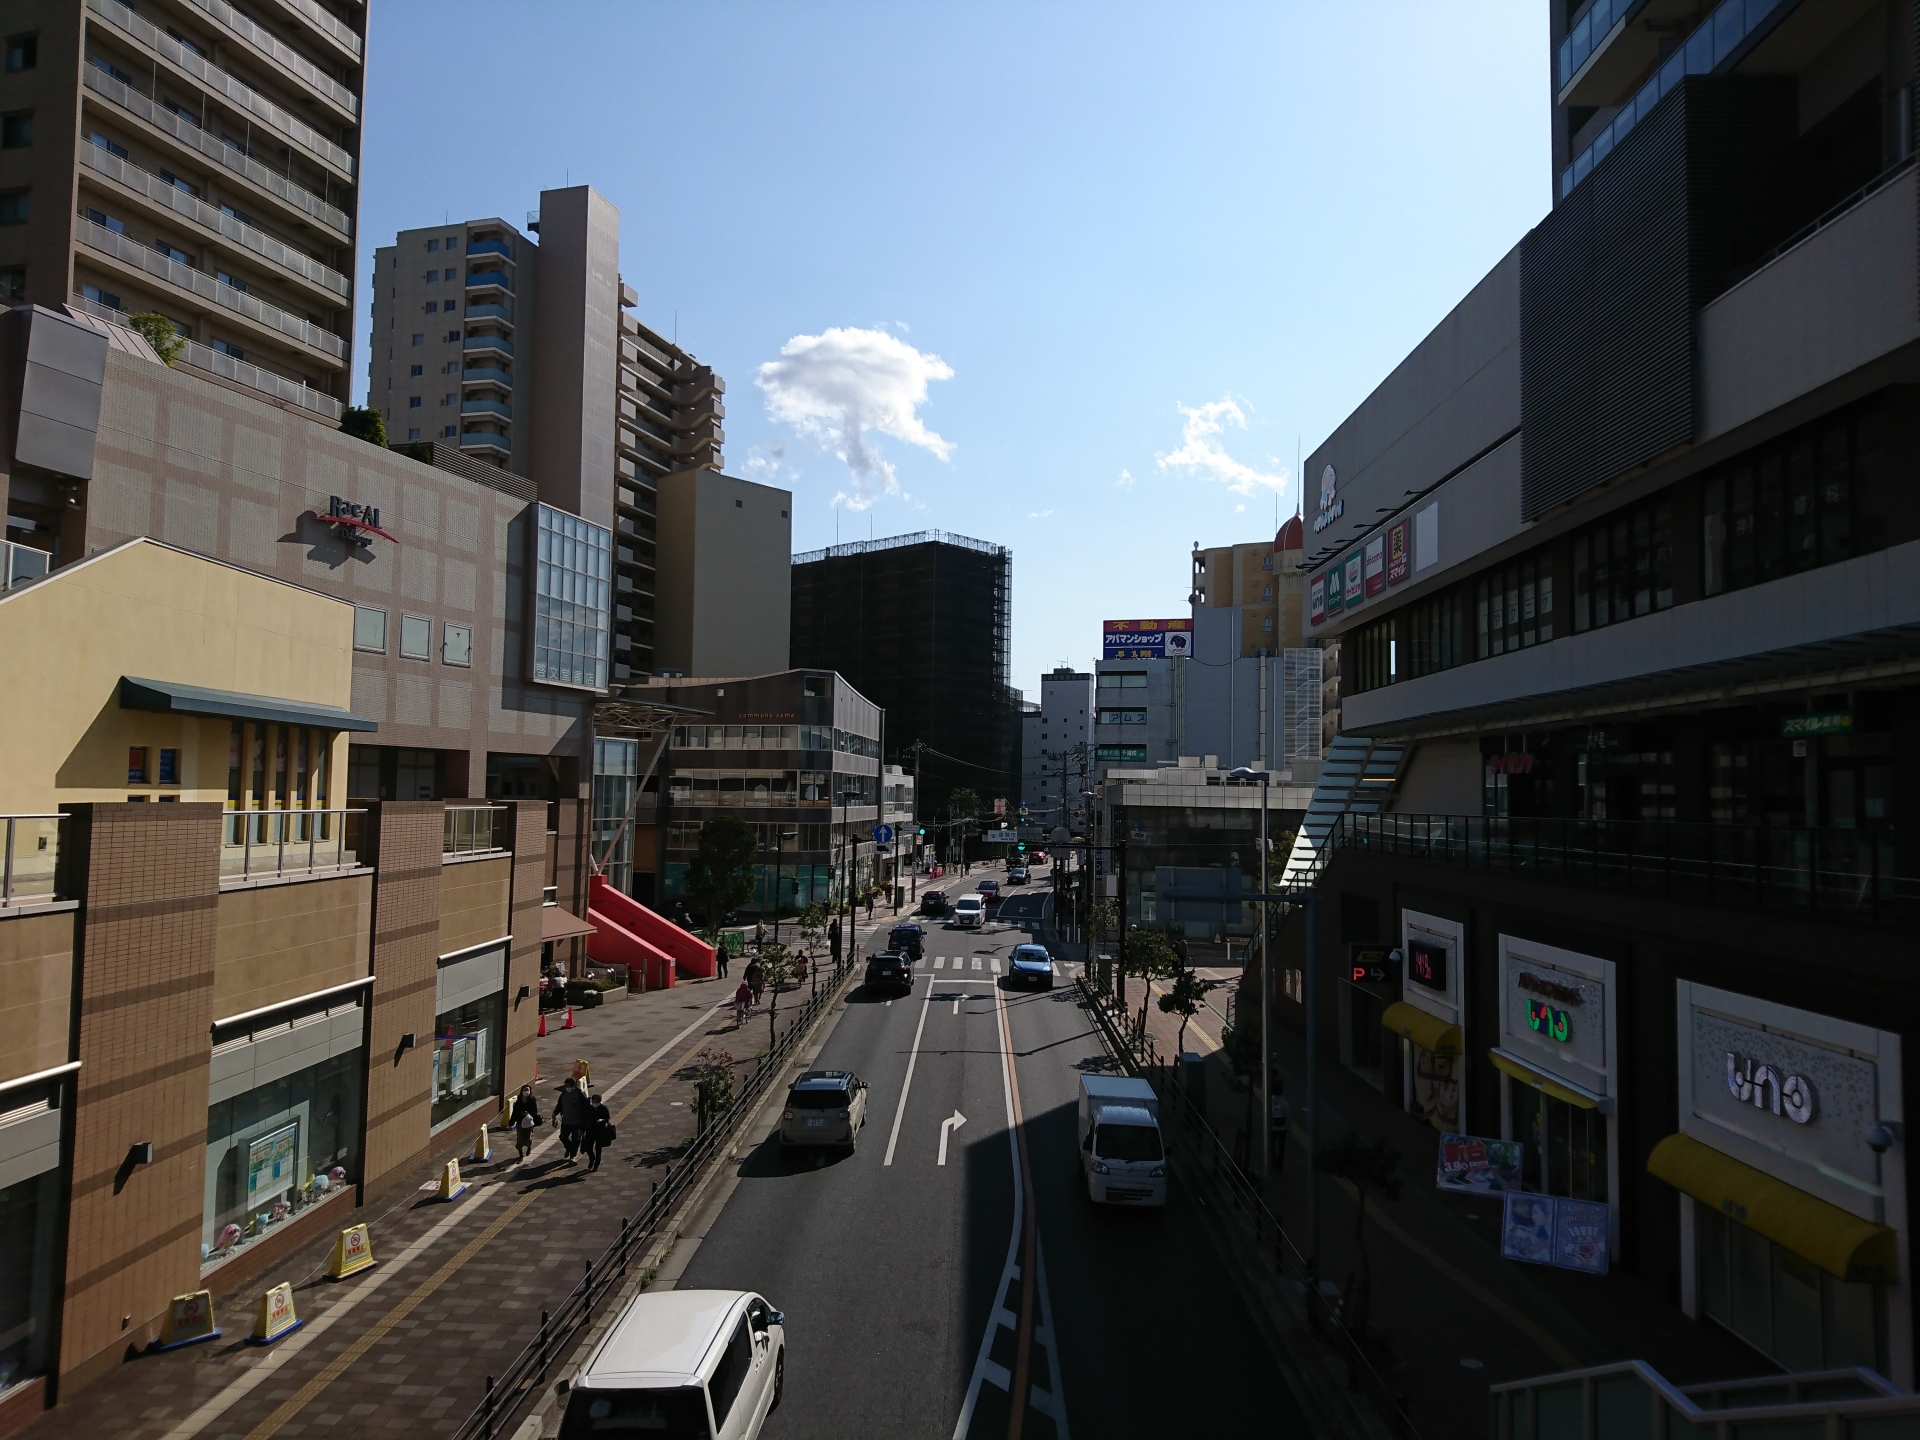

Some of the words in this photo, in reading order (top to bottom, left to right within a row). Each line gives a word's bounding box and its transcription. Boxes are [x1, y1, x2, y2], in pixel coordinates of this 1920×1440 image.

[1112, 620, 1187, 631] 不動産
[1105, 632, 1163, 644] アパマンショップ
[536, 663, 594, 686] 啓文堂書店
[1352, 967, 1366, 981] P
